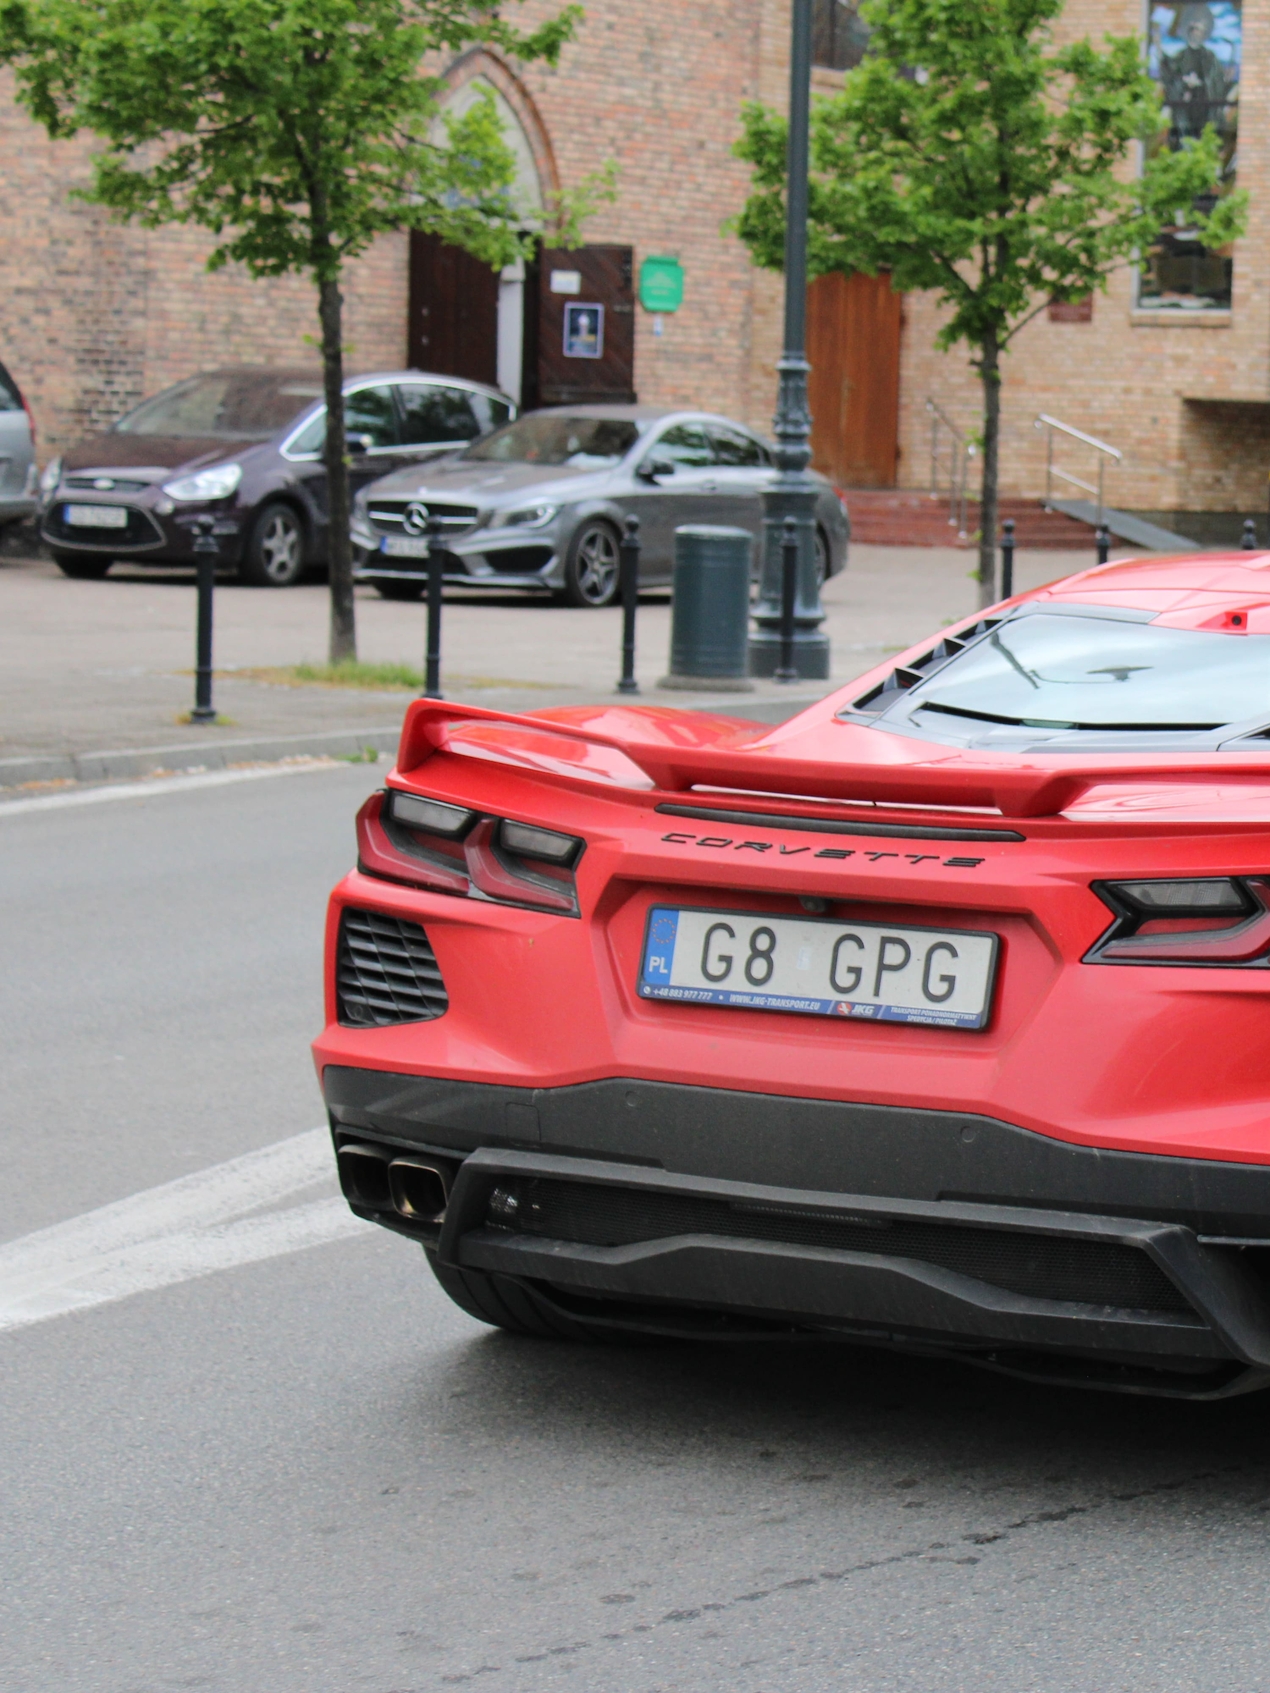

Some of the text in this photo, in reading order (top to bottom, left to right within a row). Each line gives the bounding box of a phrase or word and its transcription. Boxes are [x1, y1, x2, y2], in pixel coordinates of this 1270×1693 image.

[661, 832, 985, 867] CORVETTE
[649, 956, 668, 973] PL
[701, 922, 959, 1003] G8 GPG
[684, 990, 698, 999] 977
[698, 991, 713, 1000] 777
[729, 994, 821, 1010] WWW.JKG-TRANSPORT.EU
[852, 1004, 875, 1014] JKG
[891, 1006, 921, 1016] TRANSPORT
